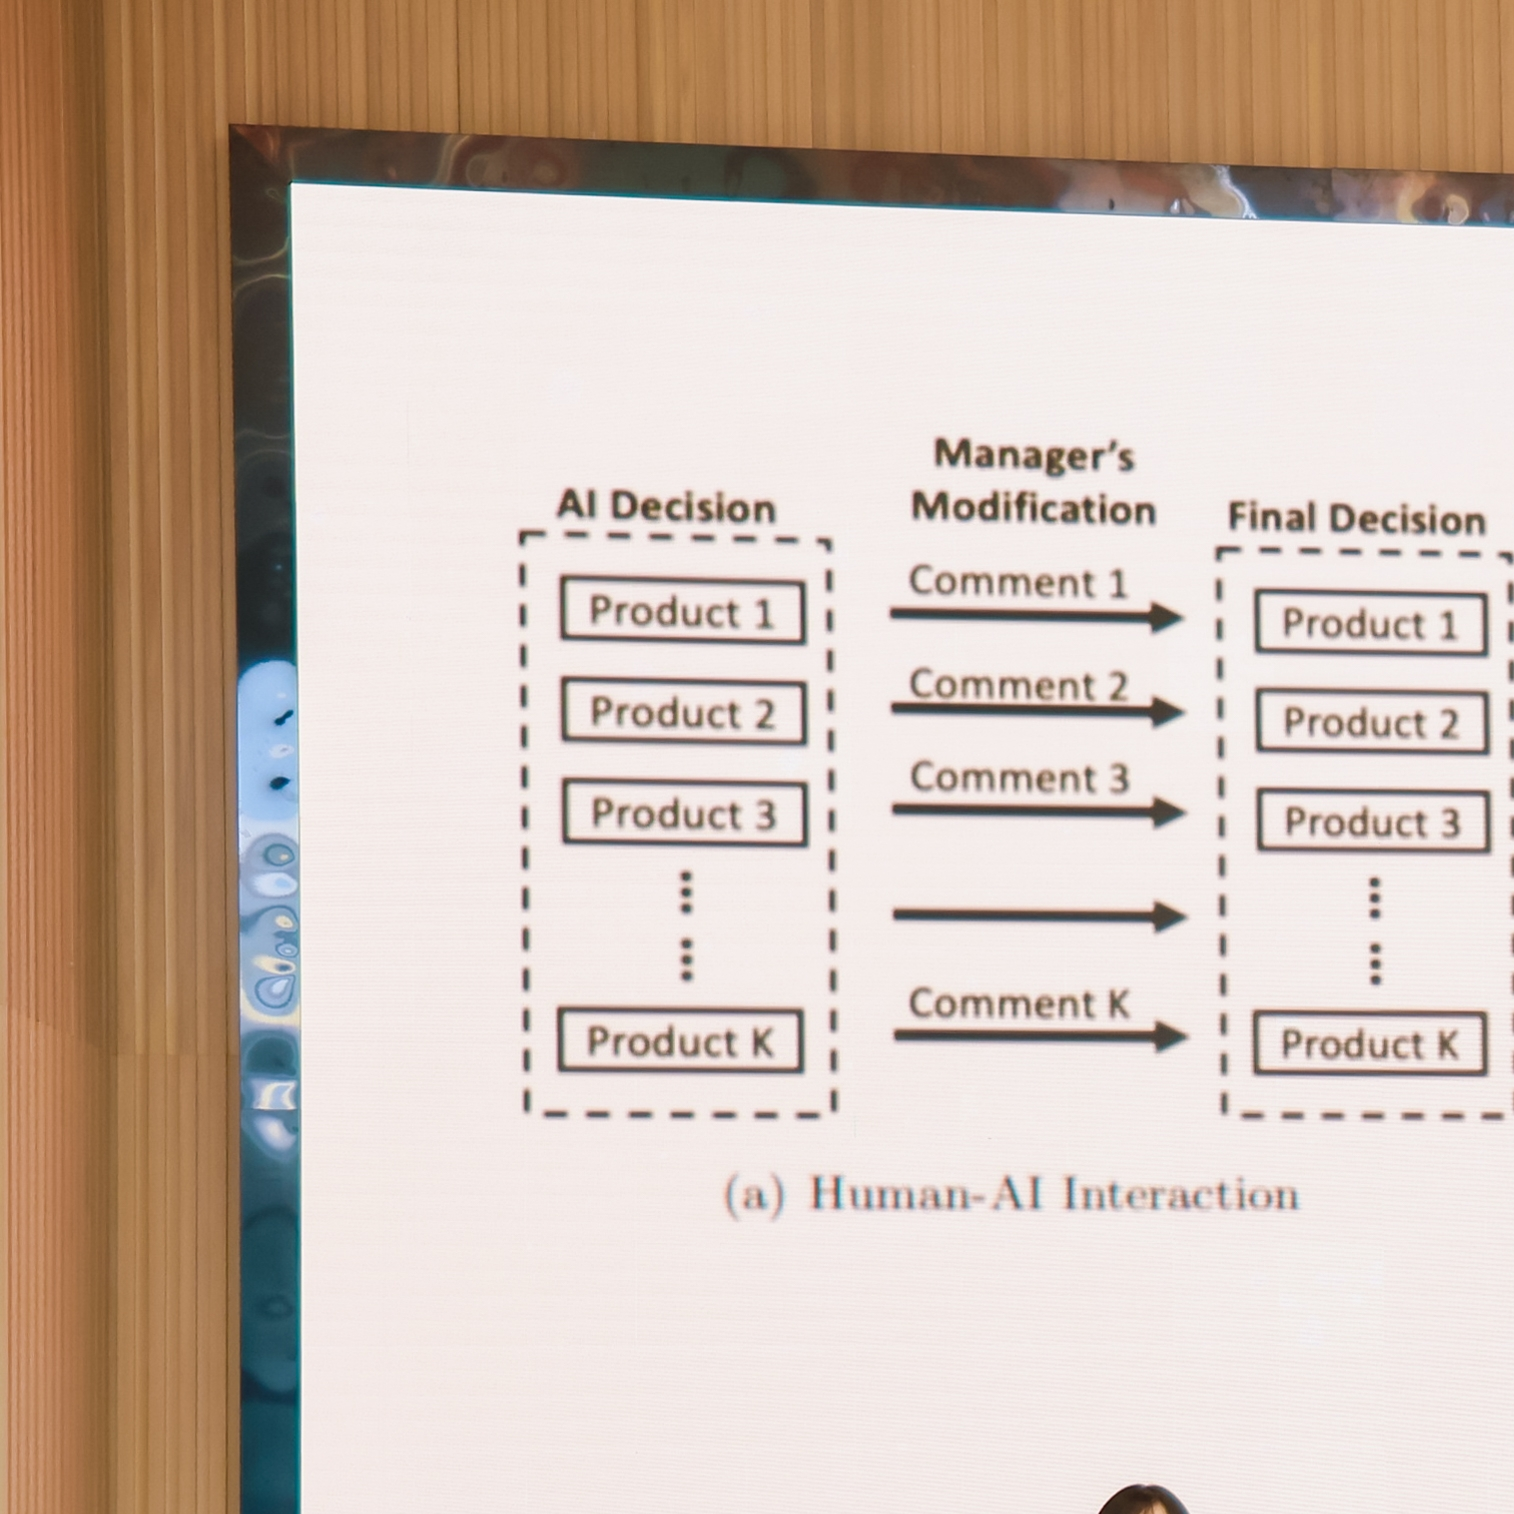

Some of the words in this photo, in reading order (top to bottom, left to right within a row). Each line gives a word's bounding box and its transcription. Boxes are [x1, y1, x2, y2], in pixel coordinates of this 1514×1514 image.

[934, 436, 1135, 478] Manager's
[555, 487, 597, 520] AI
[610, 488, 777, 525] Decision
[911, 489, 1157, 526] Modification
[1228, 500, 1316, 533] Final
[1329, 502, 1487, 537] Decision
[908, 563, 1096, 599] Comment
[1110, 568, 1128, 600] 1
[588, 593, 740, 631] Product
[756, 597, 774, 631] 1
[1283, 606, 1426, 641] Product
[1440, 609, 1458, 641] 1
[909, 666, 1096, 702] Comment
[1109, 670, 1128, 702] 2
[589, 695, 741, 732] Product
[755, 698, 775, 731] 2
[1284, 705, 1427, 740] Product
[1440, 708, 1459, 740] 2
[910, 759, 1097, 795] Comment
[1110, 762, 1131, 795] 3
[592, 796, 742, 832] Product
[756, 798, 777, 832] 3
[1285, 805, 1428, 839] Product
[1441, 807, 1462, 840] 3
[908, 986, 1096, 1021] Comment
[1108, 989, 1130, 1019] K
[587, 1024, 738, 1059] Product
[752, 1027, 774, 1059] K
[1281, 1027, 1424, 1061] Product
[1437, 1029, 1459, 1061] K
[724, 1175, 785, 1219] (a)
[811, 1174, 1042, 1212] Human-AI
[1064, 1175, 1299, 1211] Interaction
